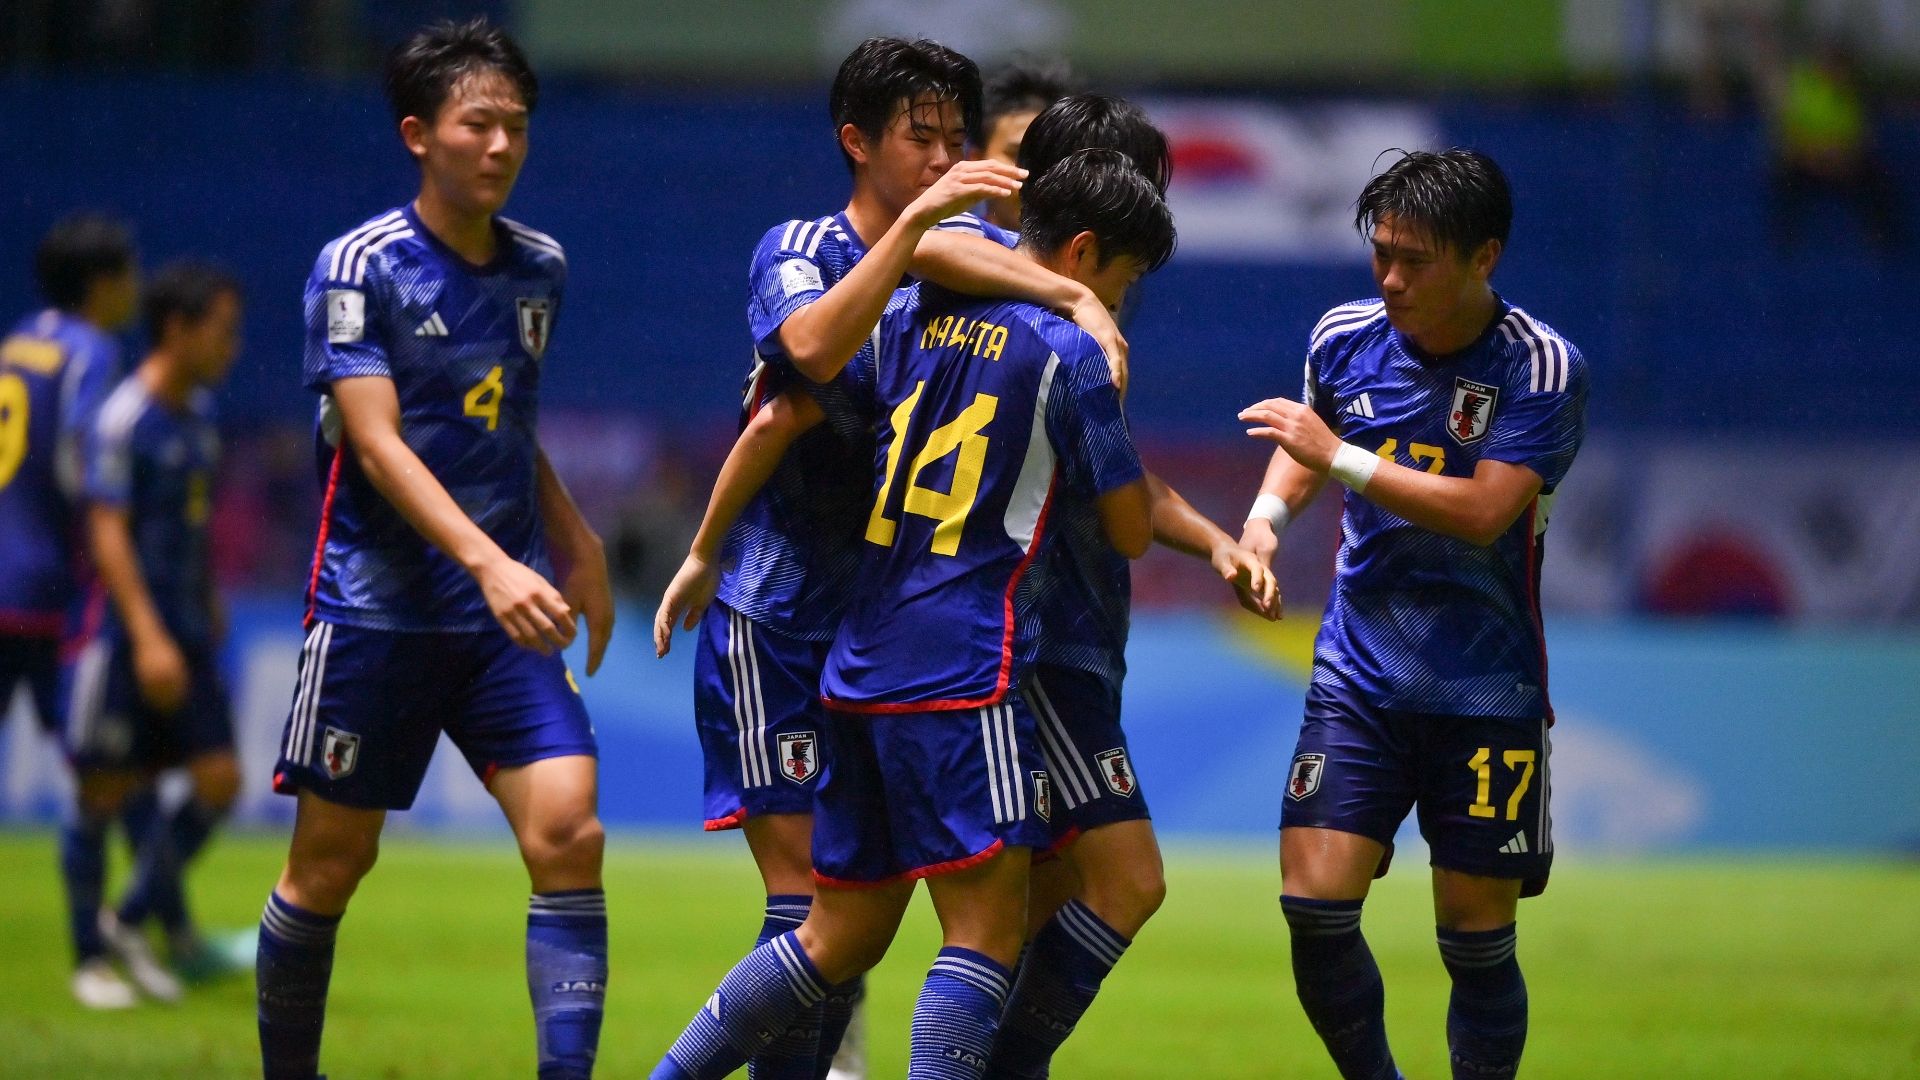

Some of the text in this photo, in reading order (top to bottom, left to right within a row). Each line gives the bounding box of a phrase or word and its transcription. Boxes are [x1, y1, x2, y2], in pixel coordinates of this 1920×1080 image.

[919, 315, 1009, 362] NAWTA
[463, 364, 503, 432] 4
[1462, 382, 1486, 393] JAPAN
[864, 379, 999, 557] 14
[1467, 747, 1536, 822] 17
